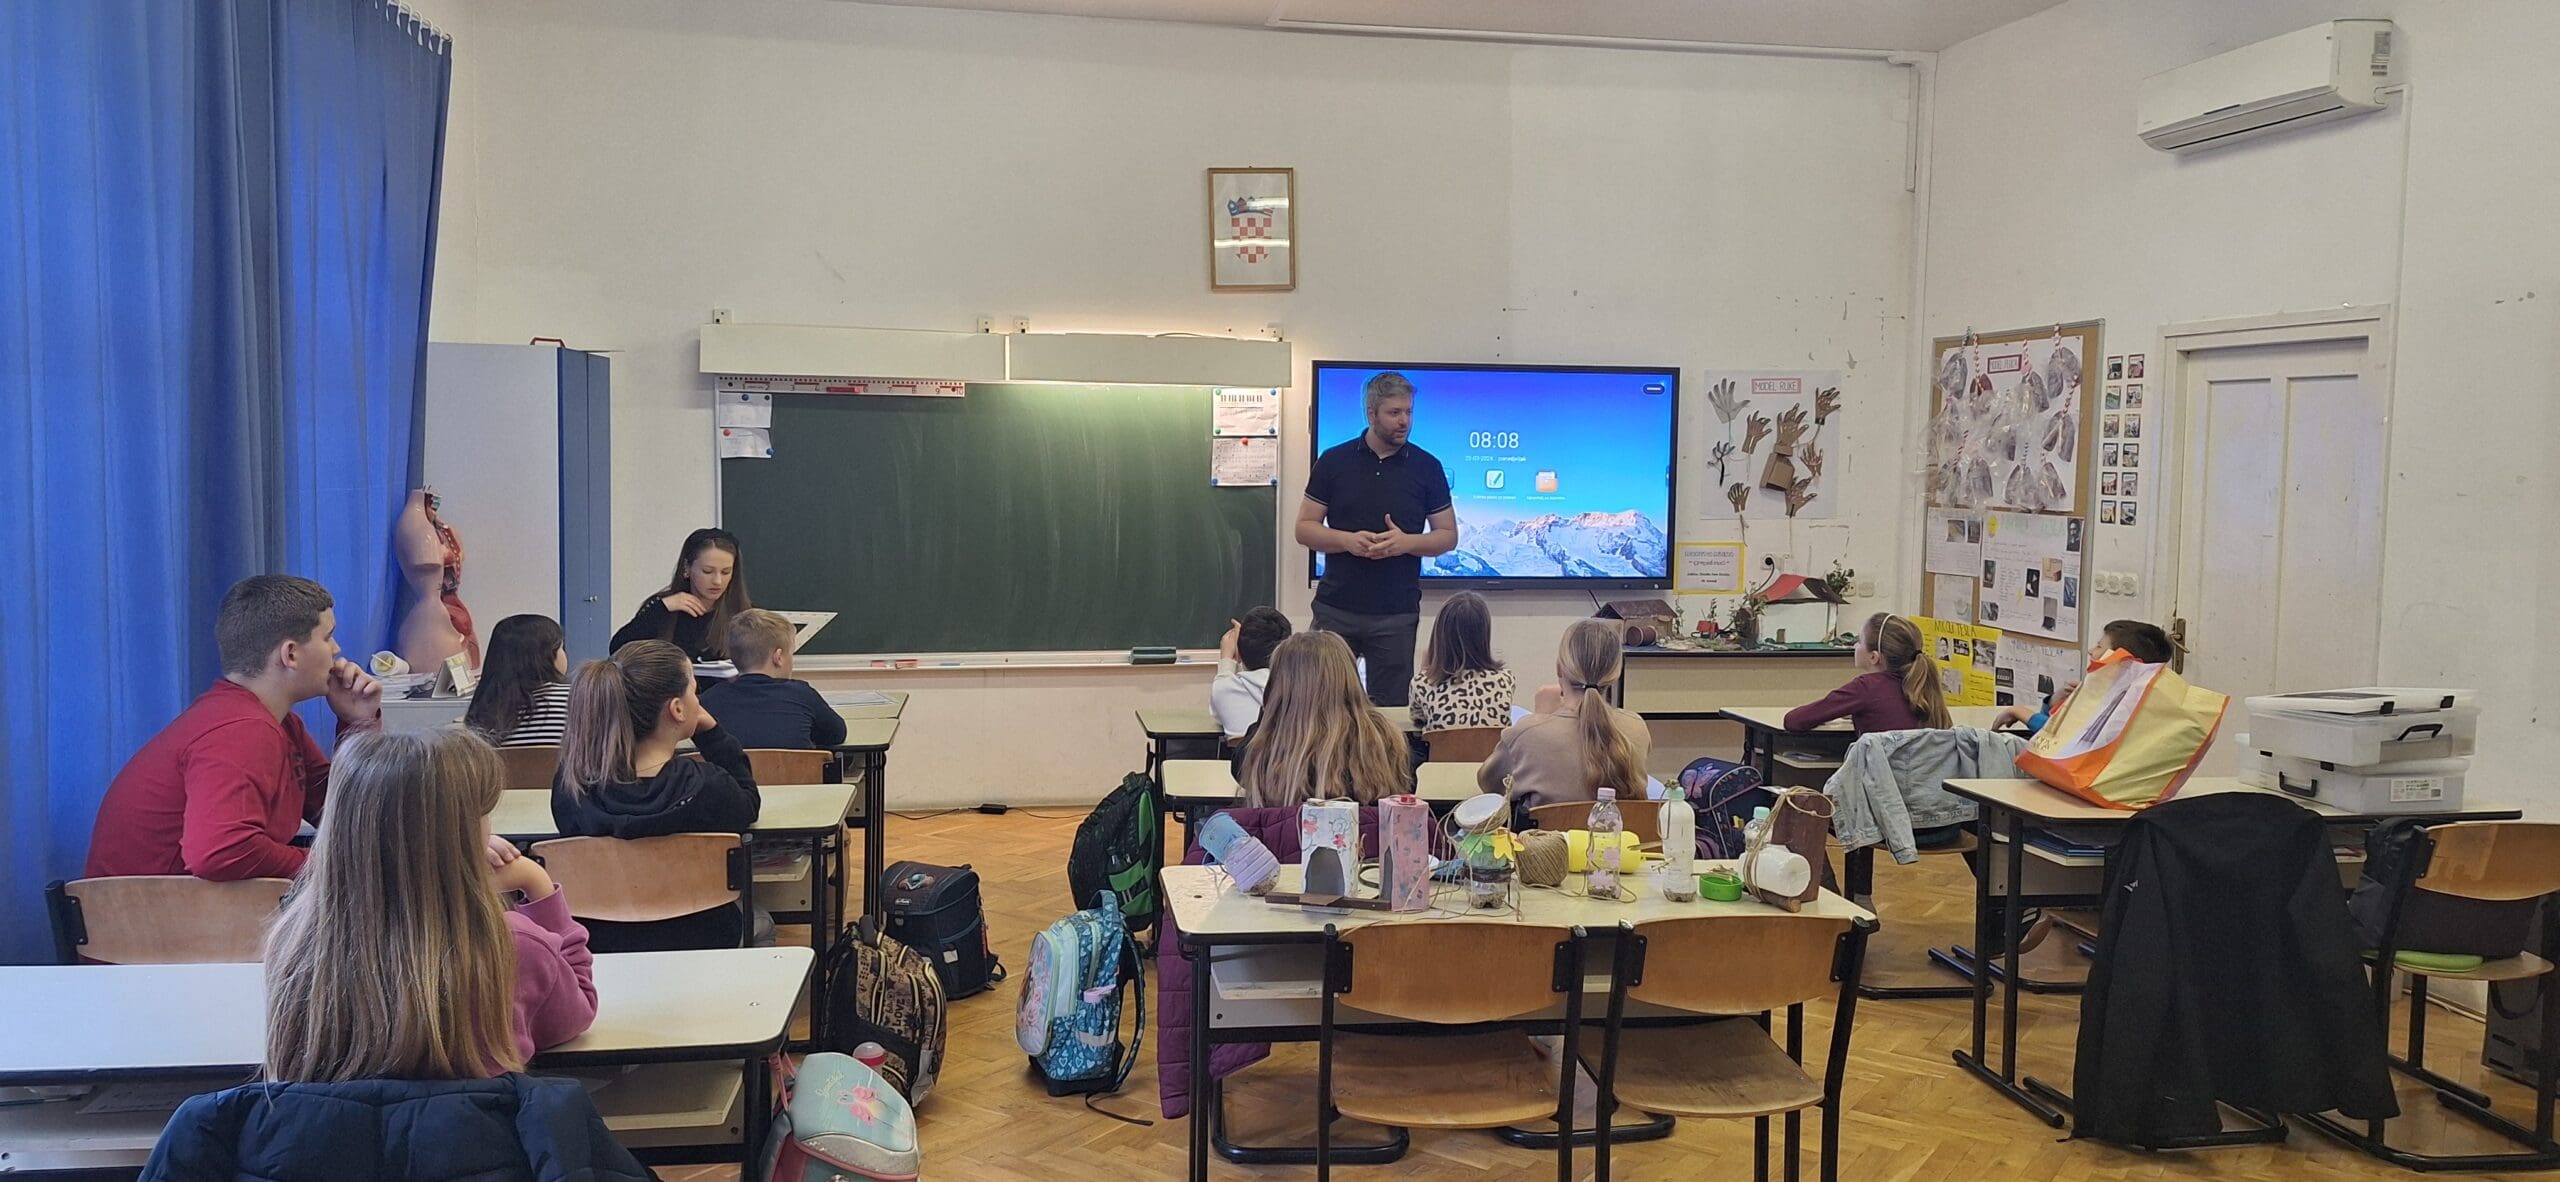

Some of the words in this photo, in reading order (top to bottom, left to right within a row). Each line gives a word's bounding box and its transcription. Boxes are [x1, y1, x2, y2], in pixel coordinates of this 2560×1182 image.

[1754, 380, 1777, 391] MODEL
[1469, 431, 1520, 449] 08:08
[892, 998, 905, 1027] LOVE
